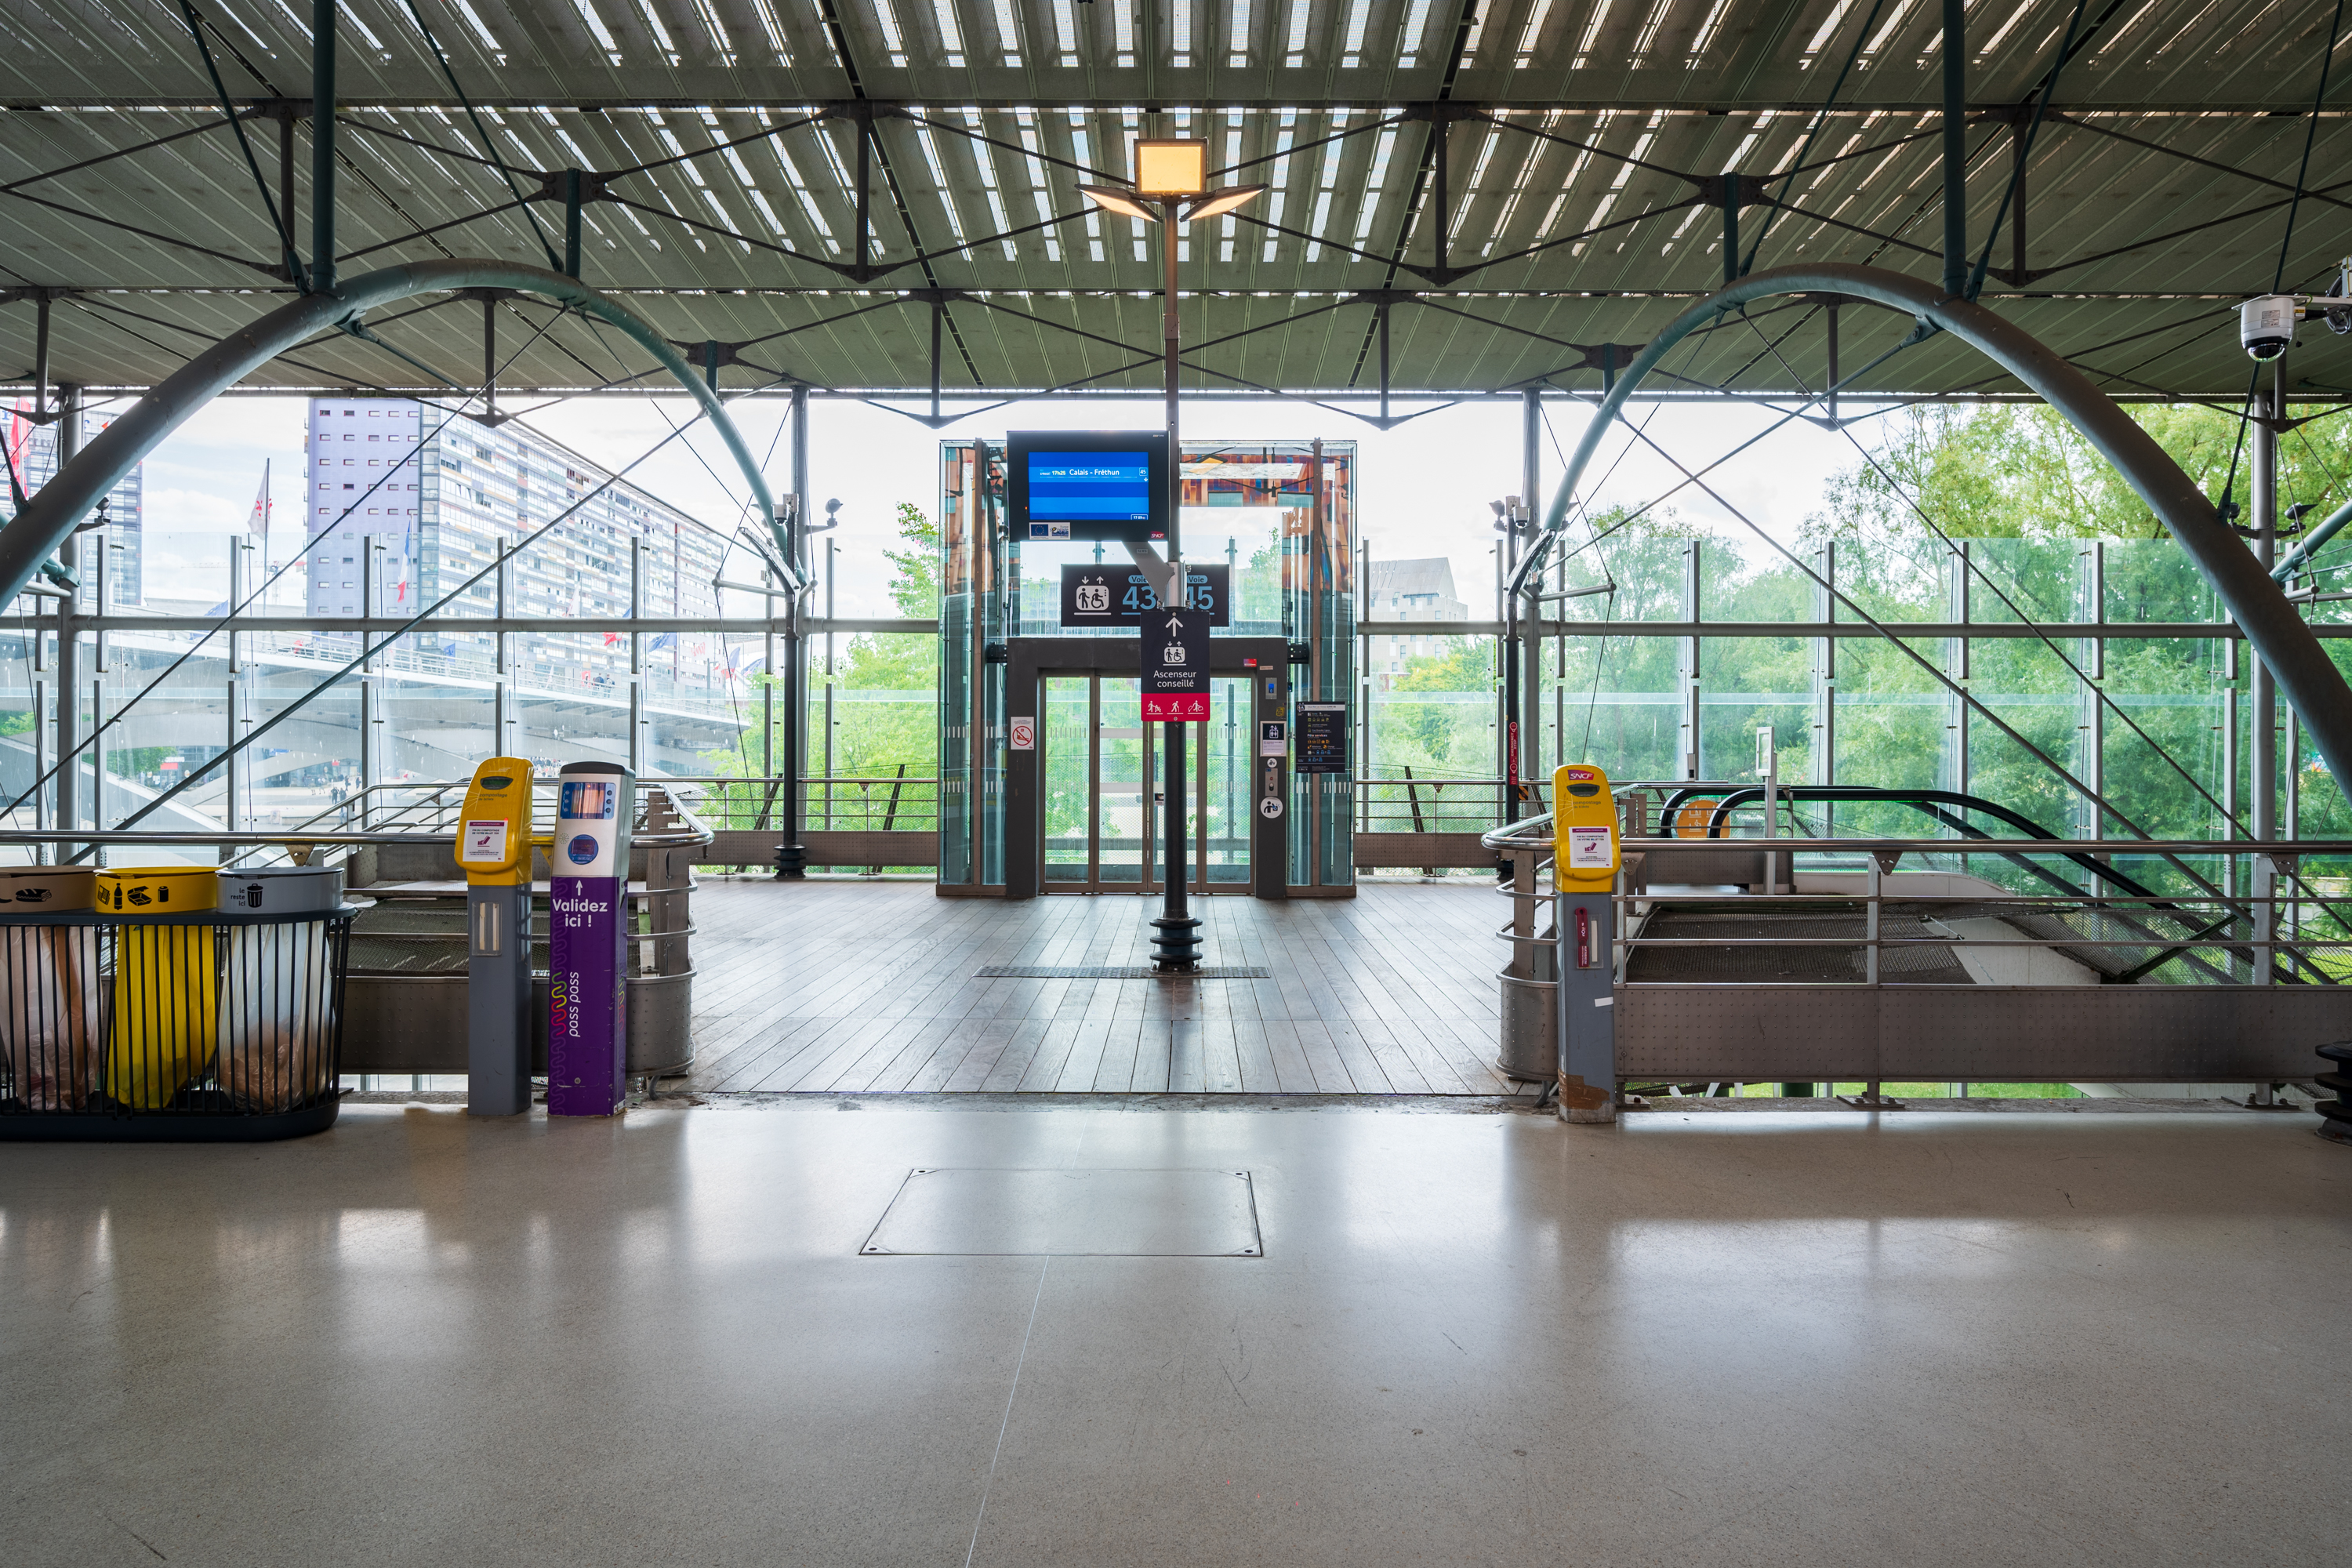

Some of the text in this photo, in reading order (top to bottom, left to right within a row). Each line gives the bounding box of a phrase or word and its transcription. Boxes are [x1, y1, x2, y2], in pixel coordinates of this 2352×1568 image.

[1122, 586, 1156, 610] 43
[1153, 670, 1197, 678] Ascenseur
[1156, 679, 1194, 688] conseillé
[552, 898, 608, 912] Validez
[565, 913, 591, 927] ici !
[569, 971, 581, 1037] pass pass
